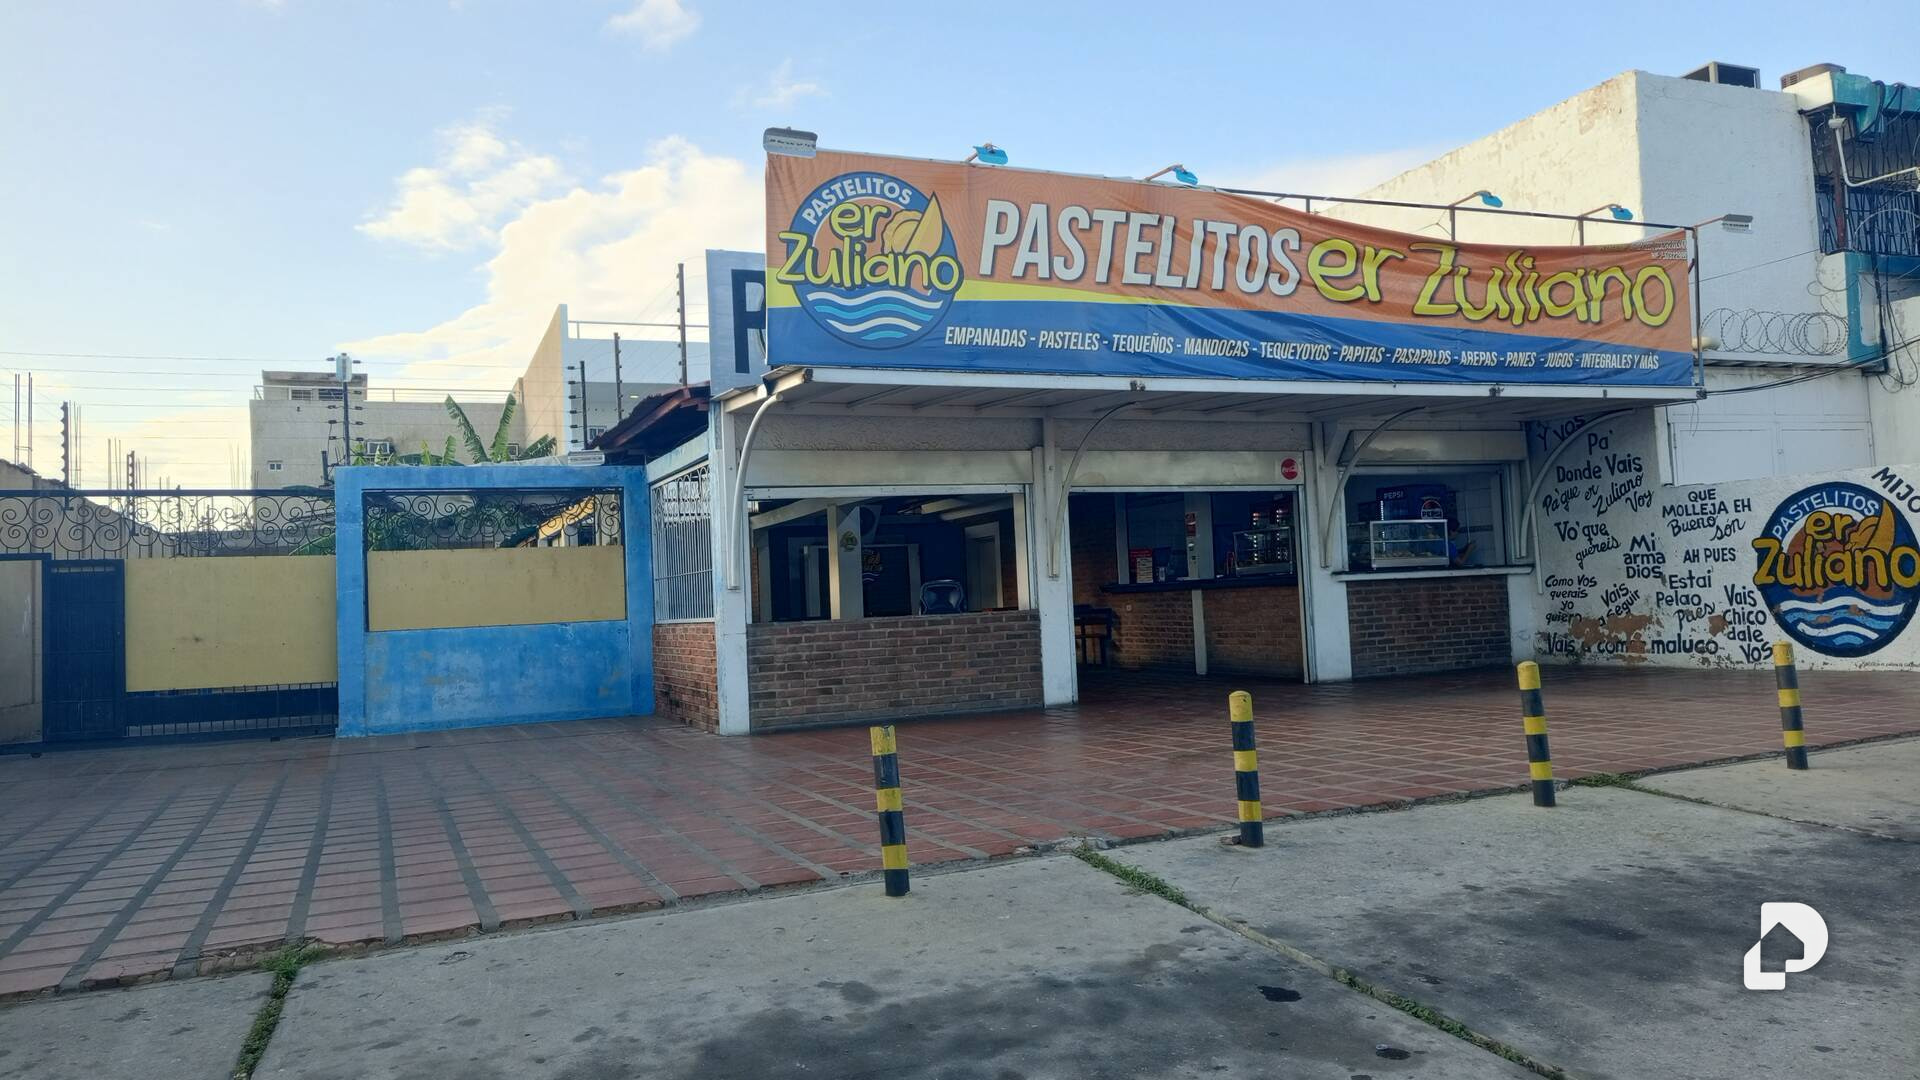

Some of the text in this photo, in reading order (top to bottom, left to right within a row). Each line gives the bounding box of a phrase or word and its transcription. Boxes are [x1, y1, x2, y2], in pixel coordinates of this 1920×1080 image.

[802, 177, 913, 225] PASTELITOS
[829, 201, 889, 239] er
[776, 231, 962, 291] Zuliano
[978, 199, 1675, 327] PASTELITOS er Zuliano
[944, 326, 1028, 348] EMPANADAS
[1038, 330, 1101, 351] PASTELES
[1112, 332, 1174, 354] TEQUEÑOS
[1184, 337, 1250, 358] MANDOCAS
[1260, 341, 1332, 361] TEQUEYOYOS
[1339, 345, 1385, 363] PAPITAS
[1391, 348, 1451, 365] PASAPALOS
[1459, 350, 1498, 367] AREPAS
[1505, 351, 1537, 367] PANES
[1544, 352, 1575, 367] JUGOS
[1580, 353, 1633, 369] INTEGRALES
[1633, 354, 1642, 369] Y
[1556, 453, 1643, 483] Donde Vais
[1584, 484, 1600, 501] er
[1592, 473, 1644, 517] Zuliano
[1625, 490, 1655, 512] Voy
[1688, 488, 1716, 502] QUE
[1662, 498, 1752, 518] MOLLEJA EH
[1772, 491, 1880, 541] PASTELITOS
[1667, 515, 1718, 537] Bueno
[1804, 511, 1854, 541] er
[1630, 532, 1656, 553] Mi
[1623, 552, 1666, 566] arma
[1683, 547, 1736, 563] AH PUES
[1752, 534, 1920, 590] Zuliano
[1545, 574, 1574, 588] Como
[1668, 569, 1712, 589] Estai
[1550, 587, 1588, 600] querais
[1601, 583, 1630, 608] Vais
[1656, 590, 1702, 608] Pelao
[1724, 584, 1757, 607] Vais
[1561, 600, 1574, 611] yo
[1722, 607, 1767, 625] Chico
[1547, 632, 1576, 655] Vais
[1651, 633, 1719, 654] maluco
[1727, 625, 1764, 643] dale
